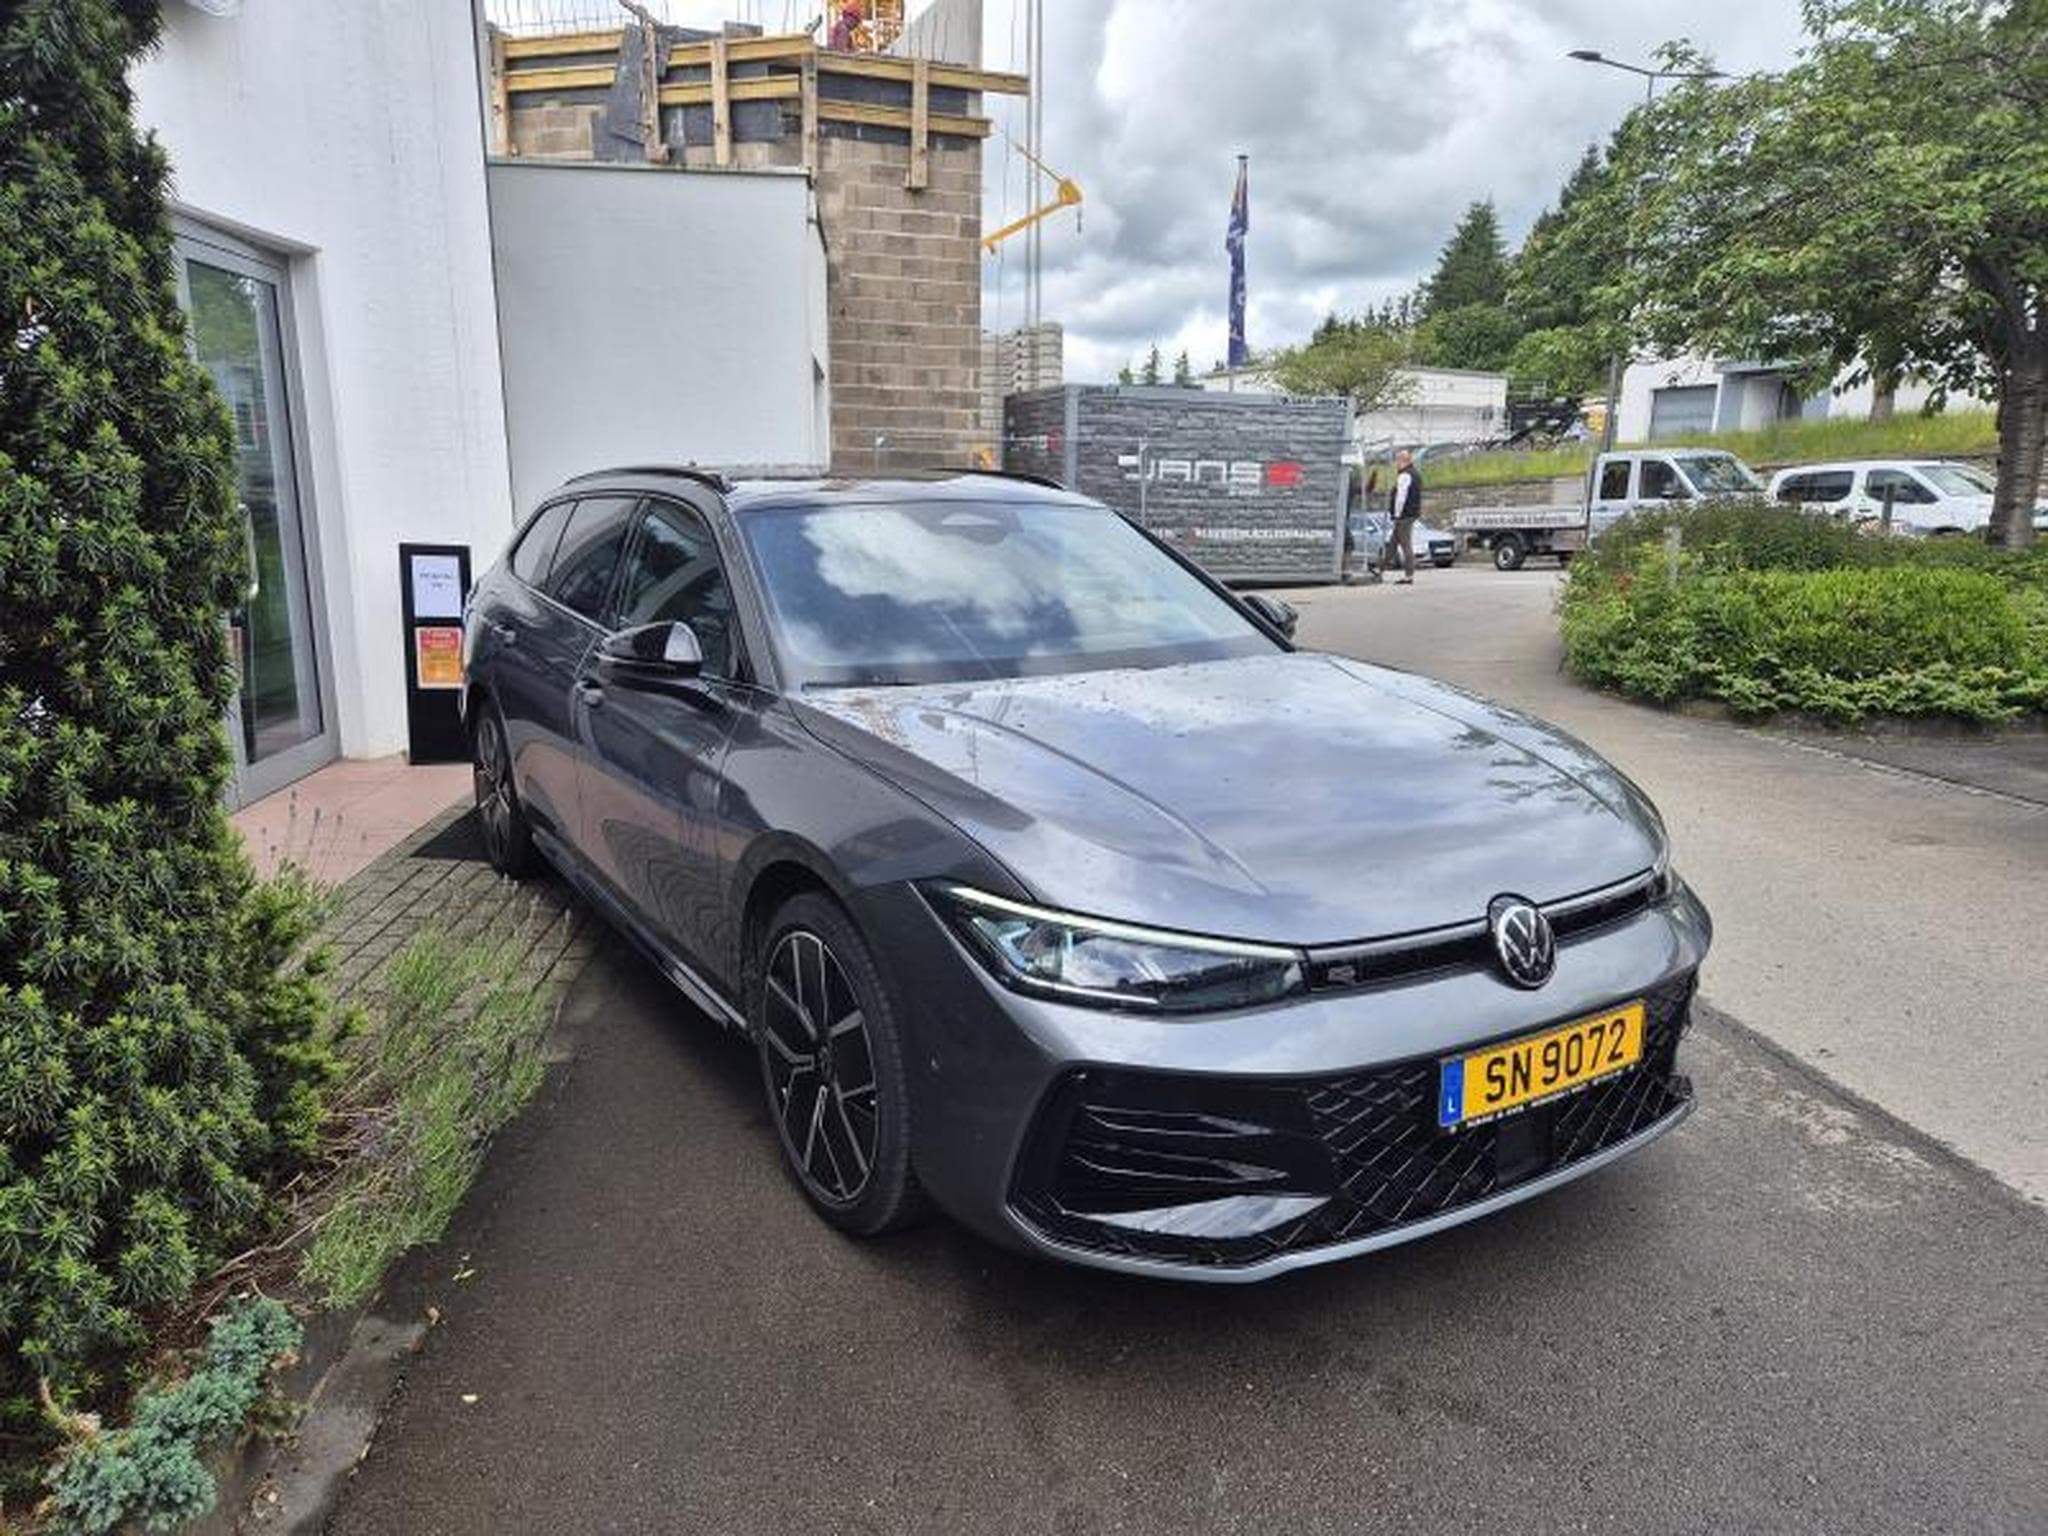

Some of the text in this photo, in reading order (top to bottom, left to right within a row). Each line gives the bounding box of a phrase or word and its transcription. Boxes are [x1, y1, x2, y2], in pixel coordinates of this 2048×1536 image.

[1486, 1018, 1627, 1103] SN 9072
[1447, 1096, 1456, 1114] L
